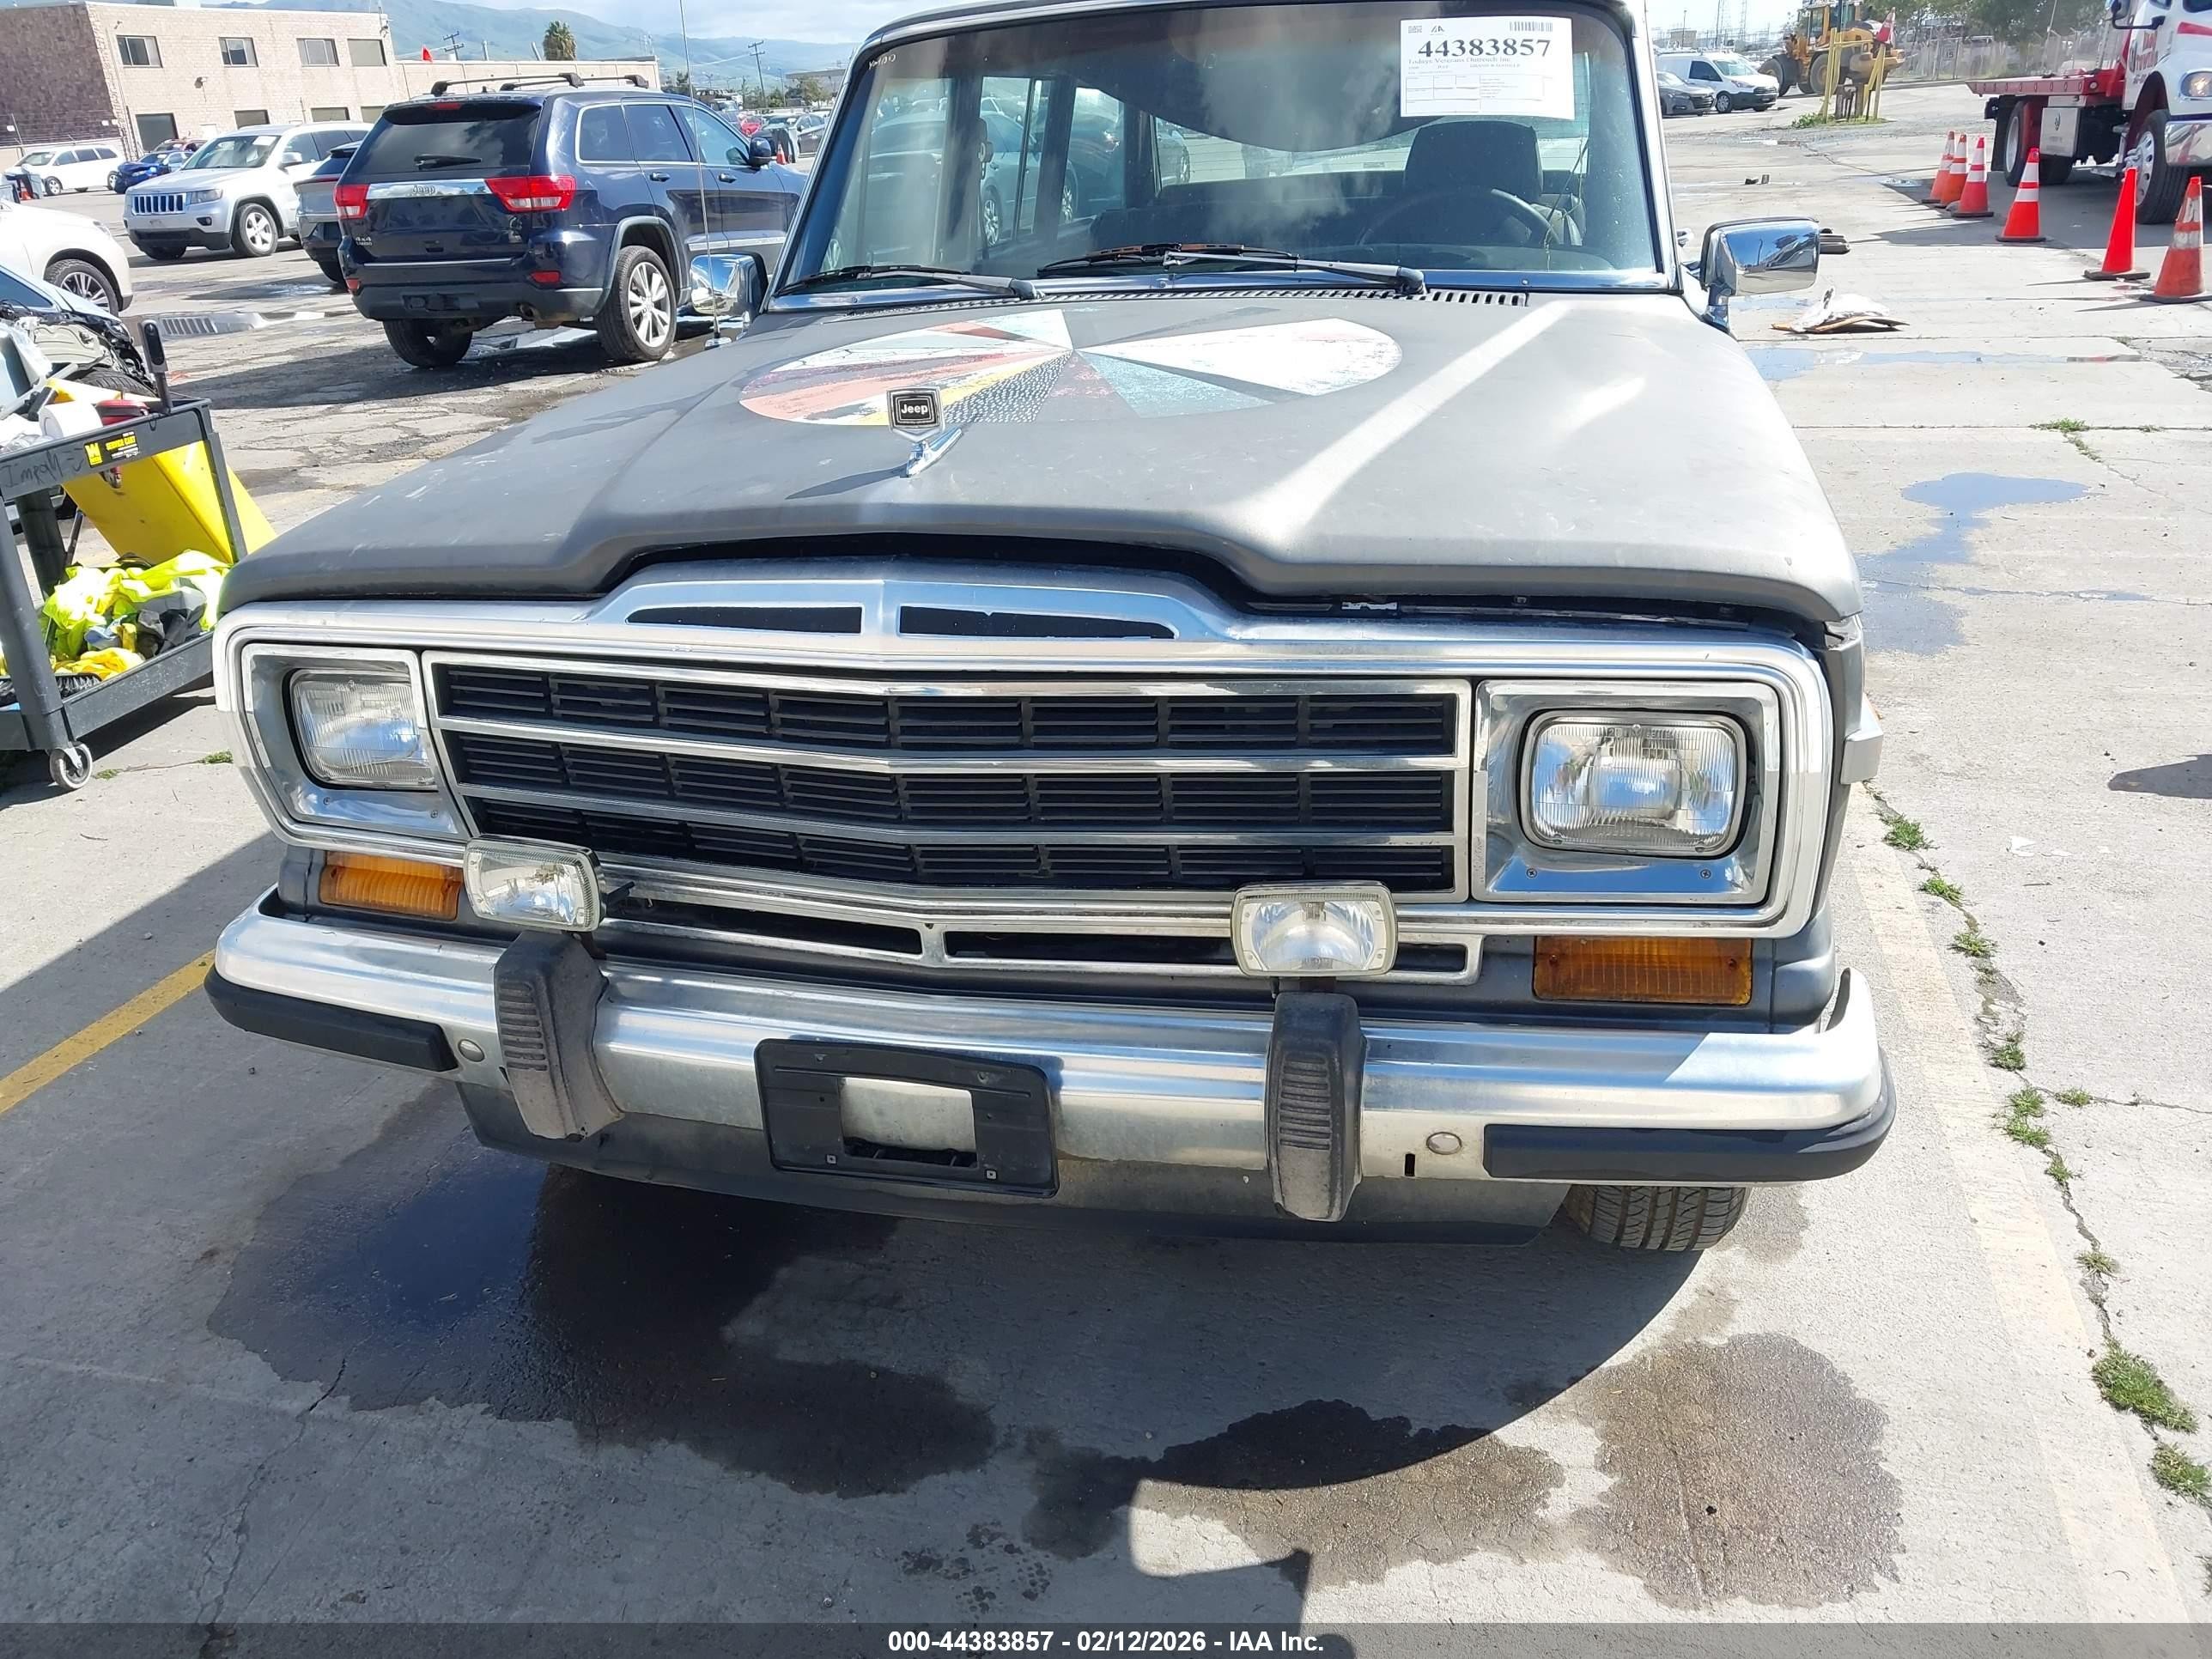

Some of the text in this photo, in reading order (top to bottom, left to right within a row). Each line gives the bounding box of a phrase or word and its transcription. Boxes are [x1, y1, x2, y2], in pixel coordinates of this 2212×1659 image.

[1418, 38, 1551, 57] 44383857
[412, 185, 435, 196] Jeep
[901, 404, 928, 415] Jeep
